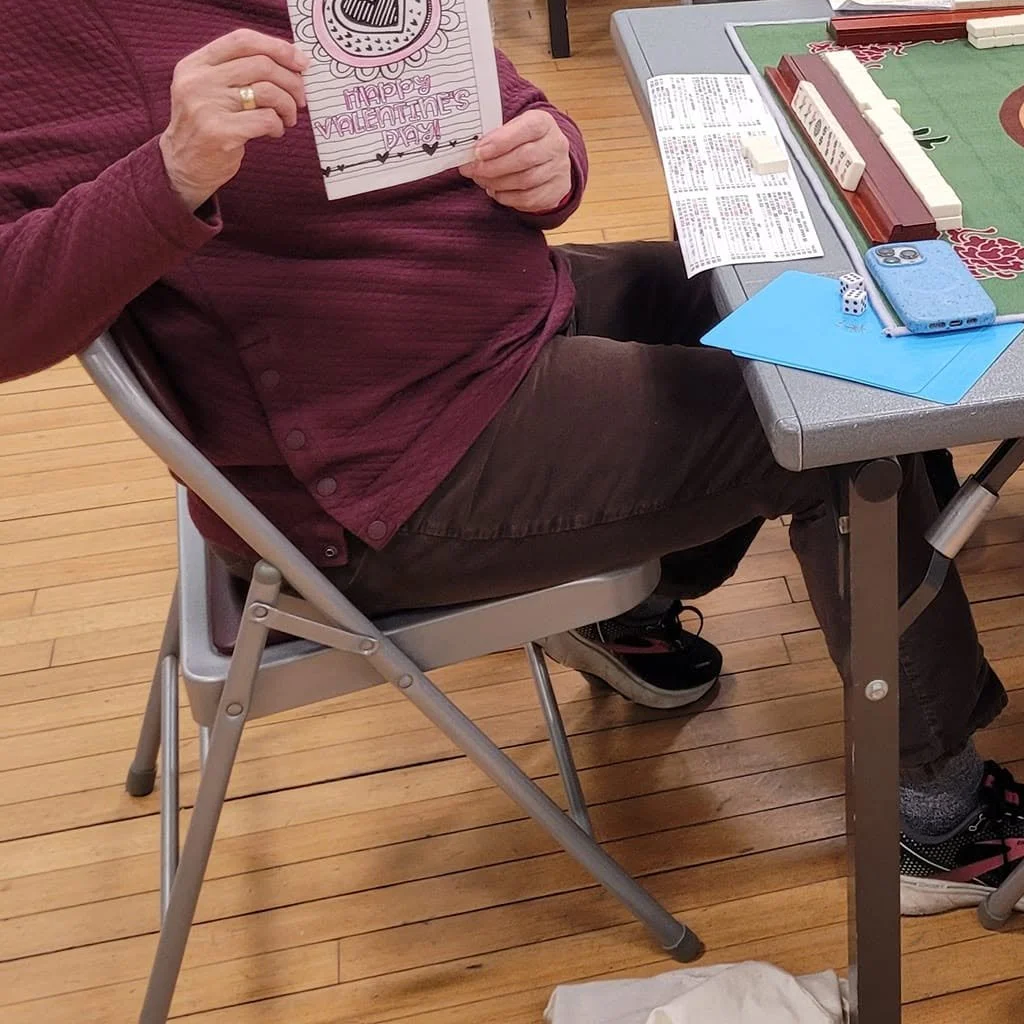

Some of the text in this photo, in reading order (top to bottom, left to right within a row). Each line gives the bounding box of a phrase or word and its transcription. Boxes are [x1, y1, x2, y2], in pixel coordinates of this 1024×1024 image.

[343, 75, 432, 112] HAPPY
[313, 89, 471, 141] VALENTINE'S
[383, 120, 442, 152] DAY!
